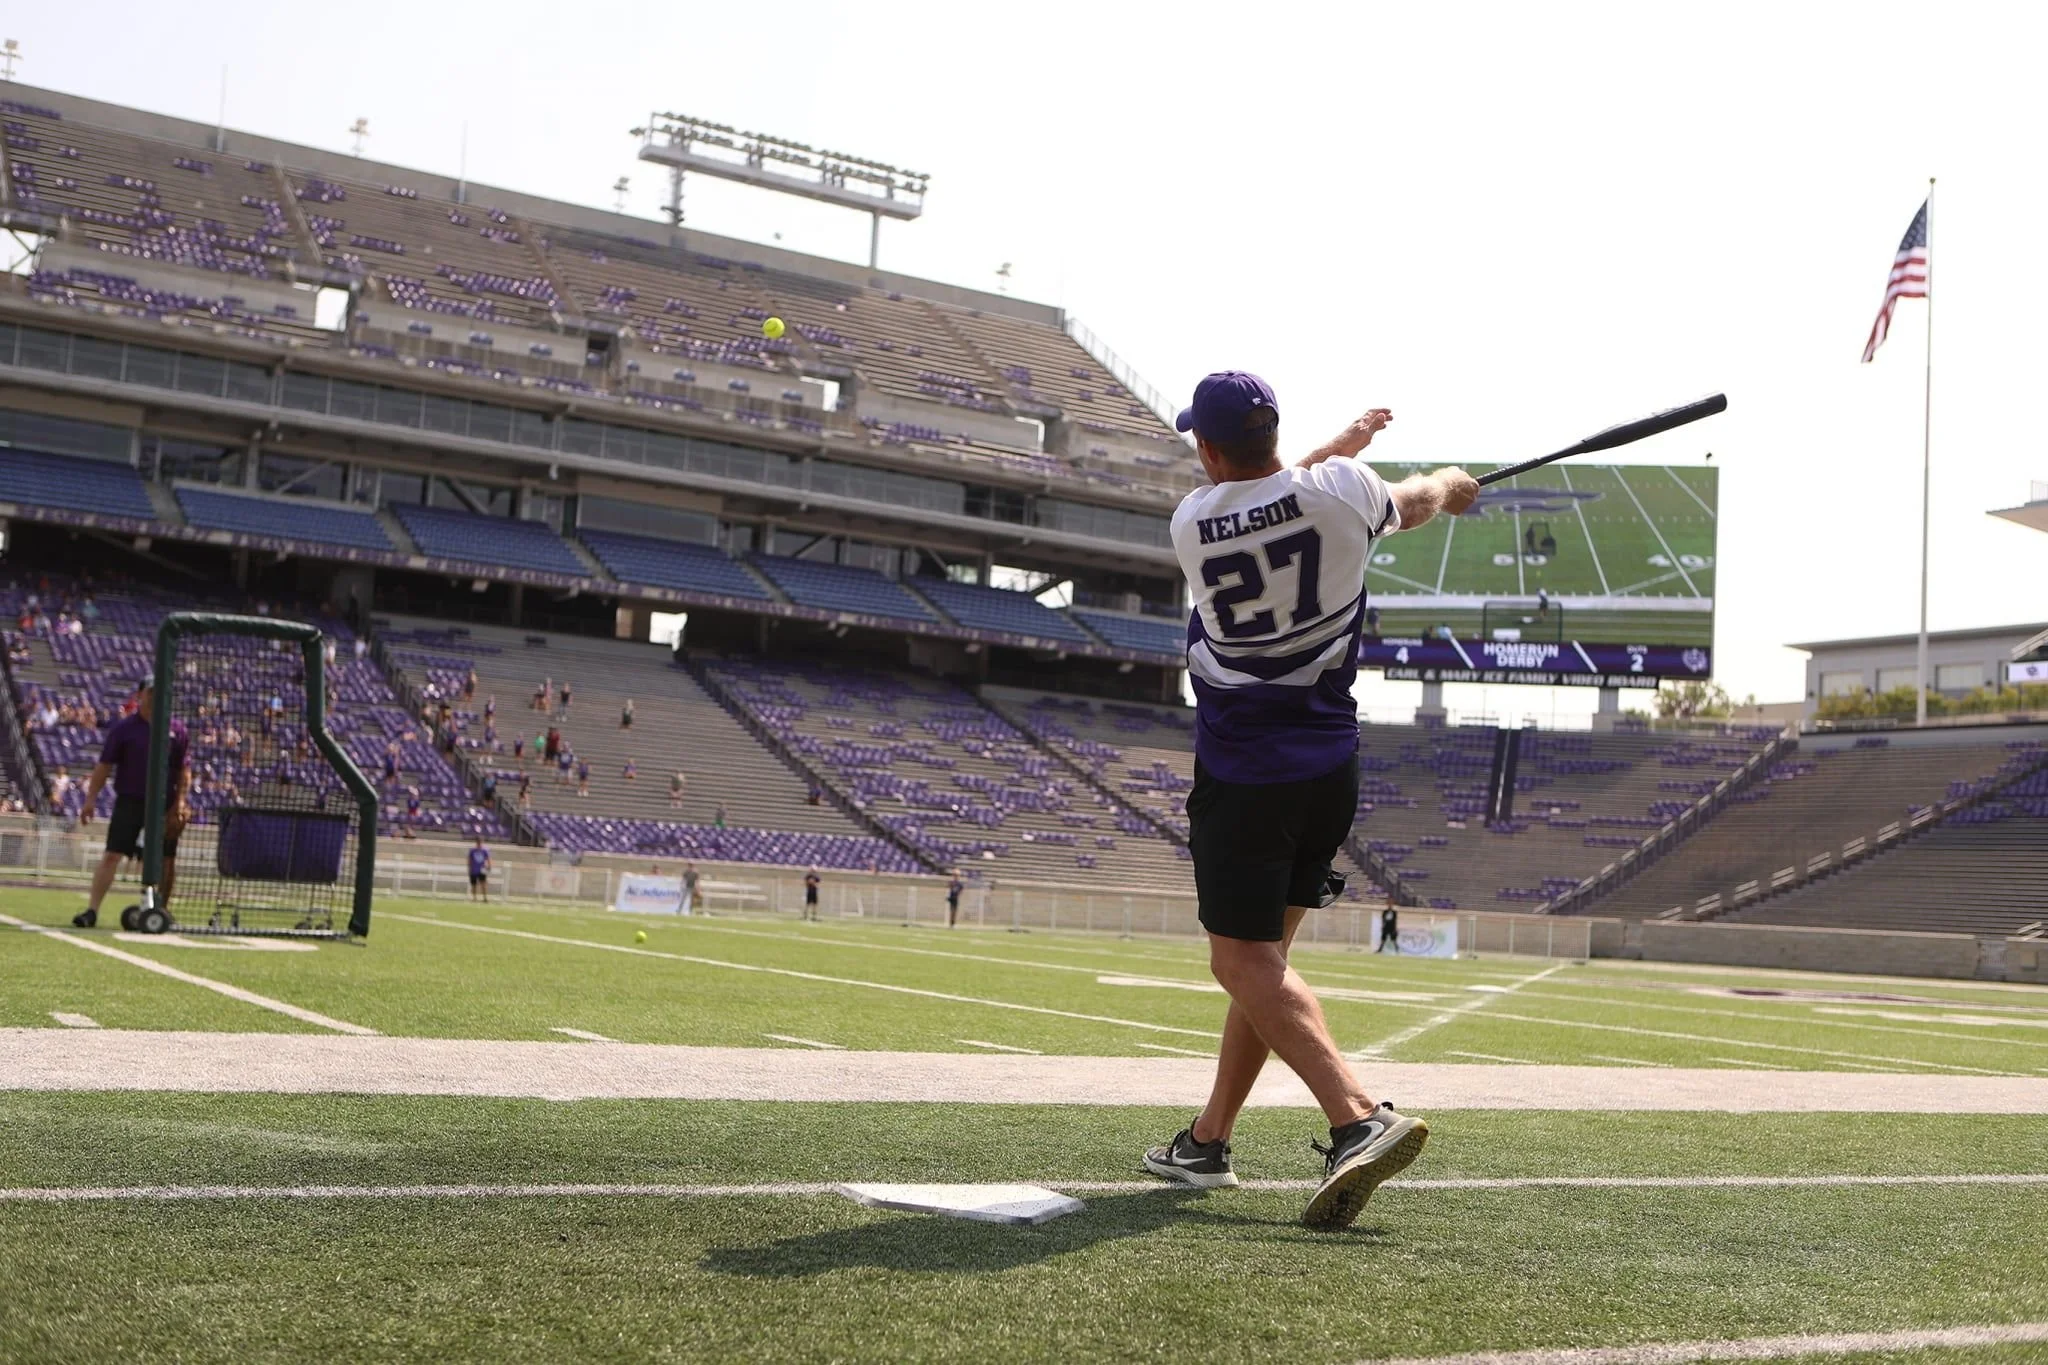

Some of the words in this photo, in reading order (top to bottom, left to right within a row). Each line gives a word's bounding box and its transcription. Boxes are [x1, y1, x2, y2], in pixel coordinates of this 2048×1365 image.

[1197, 493, 1304, 545] NELSON
[1201, 525, 1323, 639] 27
[1395, 646, 1409, 665] 4
[1483, 642, 1559, 659] HOMERUN
[1496, 655, 1547, 668] DERBY
[1630, 654, 1644, 673] 2
[1386, 668, 1420, 680] CARL
[1423, 669, 1436, 680] &
[1439, 670, 1480, 682] MARY
[1484, 671, 1505, 683] ICE
[1508, 672, 1557, 684] FAMILY
[1561, 674, 1605, 686] VIDEO
[1606, 676, 1657, 688] BOARD
